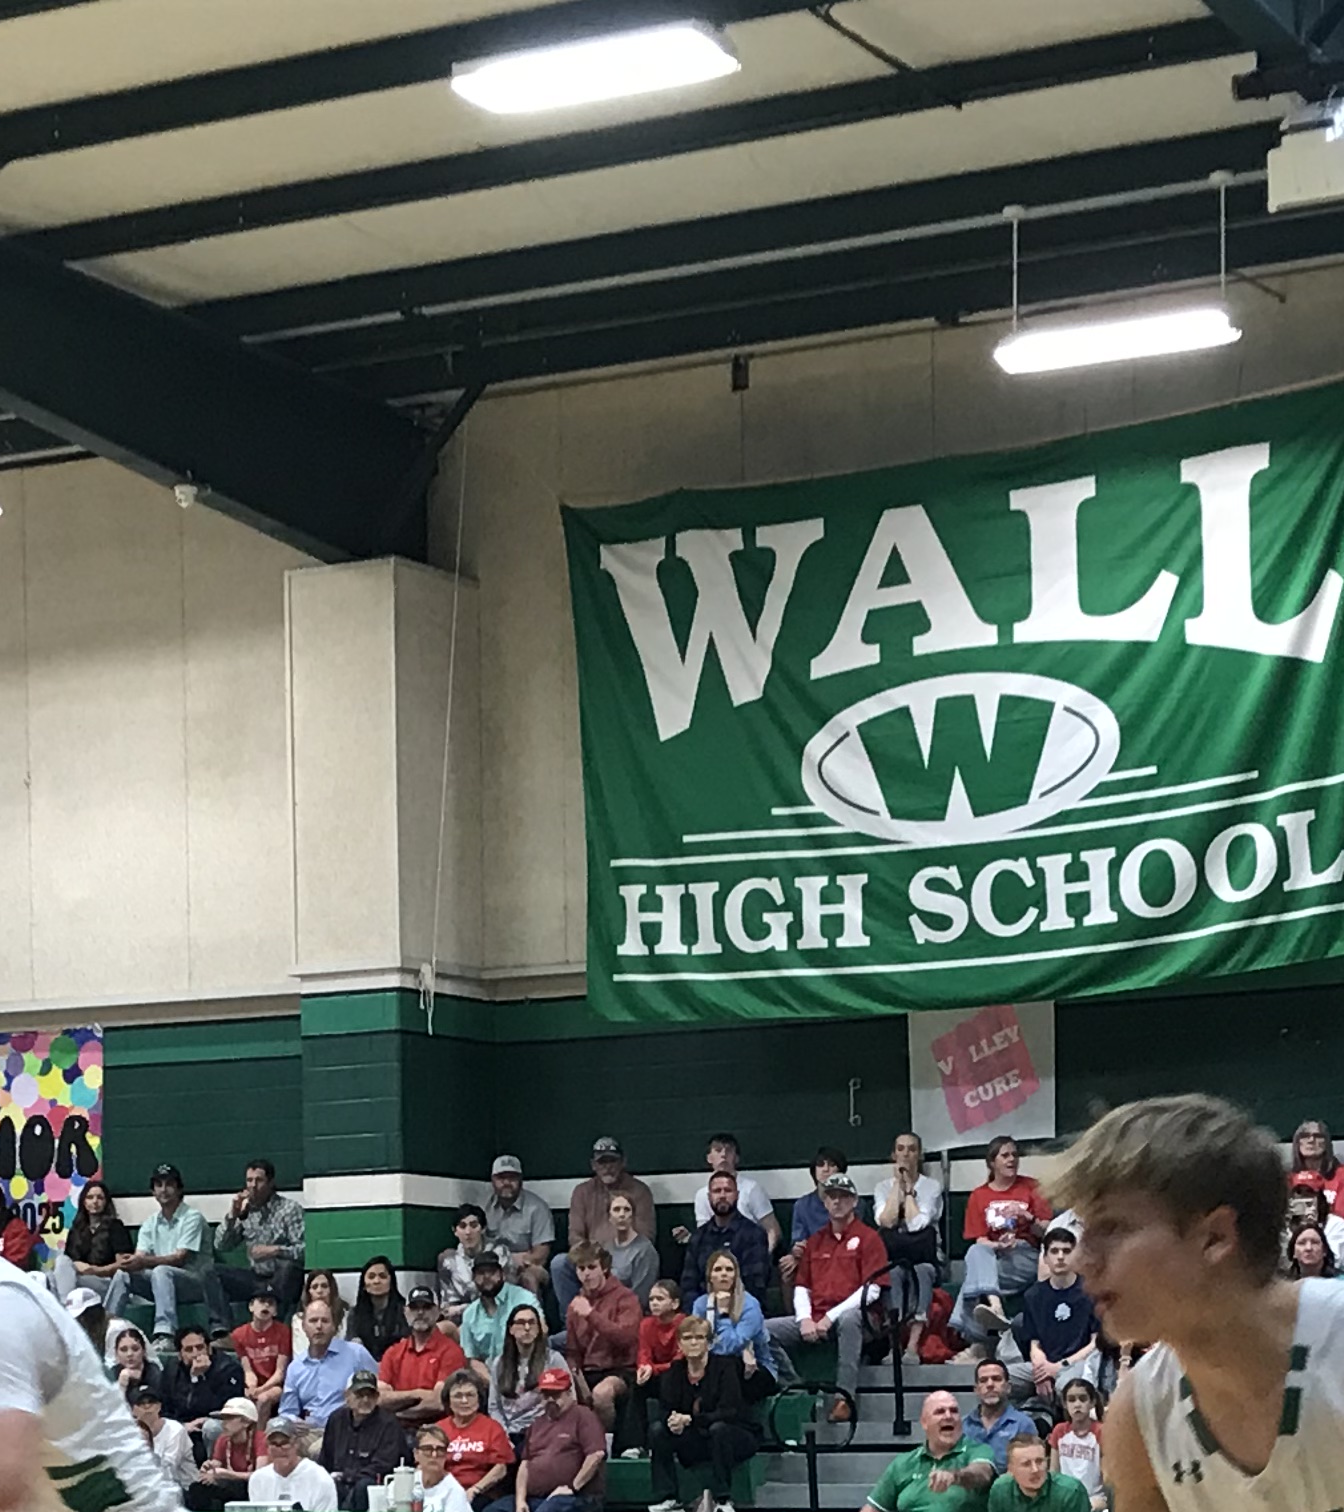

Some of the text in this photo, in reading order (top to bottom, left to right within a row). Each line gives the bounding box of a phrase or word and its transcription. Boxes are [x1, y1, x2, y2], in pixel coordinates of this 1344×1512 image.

[599, 441, 1344, 742] WALL
[856, 692, 1057, 821] W
[616, 872, 871, 957] HIGH
[964, 1069, 1022, 1108] CURE
